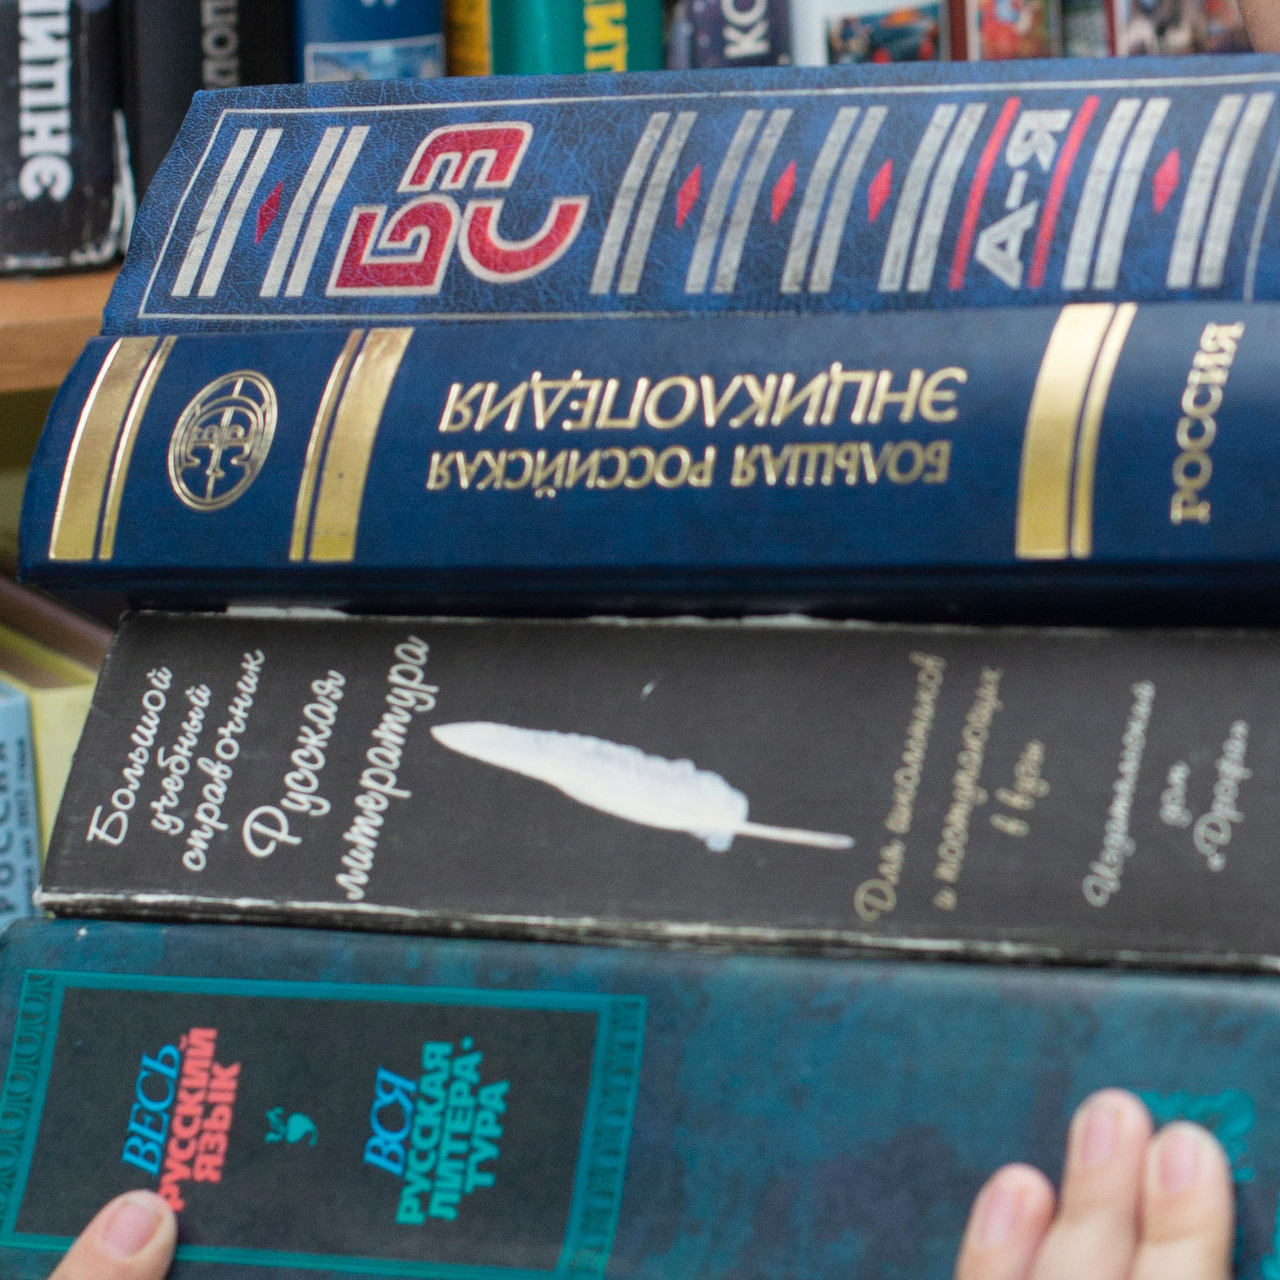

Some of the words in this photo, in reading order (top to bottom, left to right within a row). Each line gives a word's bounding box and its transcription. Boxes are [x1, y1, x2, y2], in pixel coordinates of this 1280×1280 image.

[974, 107, 1074, 290] А-Я
[426, 444, 717, 499] РОССИЙСКАЯ
[438, 360, 968, 433] ЭНЦИКЛОПЕДИЯ
[730, 438, 953, 488] БОЛЬШАЯ
[1169, 320, 1245, 527] РОССИЯ
[86, 665, 173, 846] Большой
[150, 682, 212, 837] учебный
[180, 648, 266, 873] справочник
[242, 669, 346, 859] Русская
[335, 634, 439, 903] литература
[120, 1042, 182, 1177] ВЕСЬ
[157, 1025, 219, 1212] РУССКИЙ
[192, 1060, 242, 1185] ЯЗЫК
[363, 1064, 417, 1177] ВСЯ
[394, 1039, 455, 1227] РУССКАЯ
[464, 1077, 511, 1196] ТУРА
